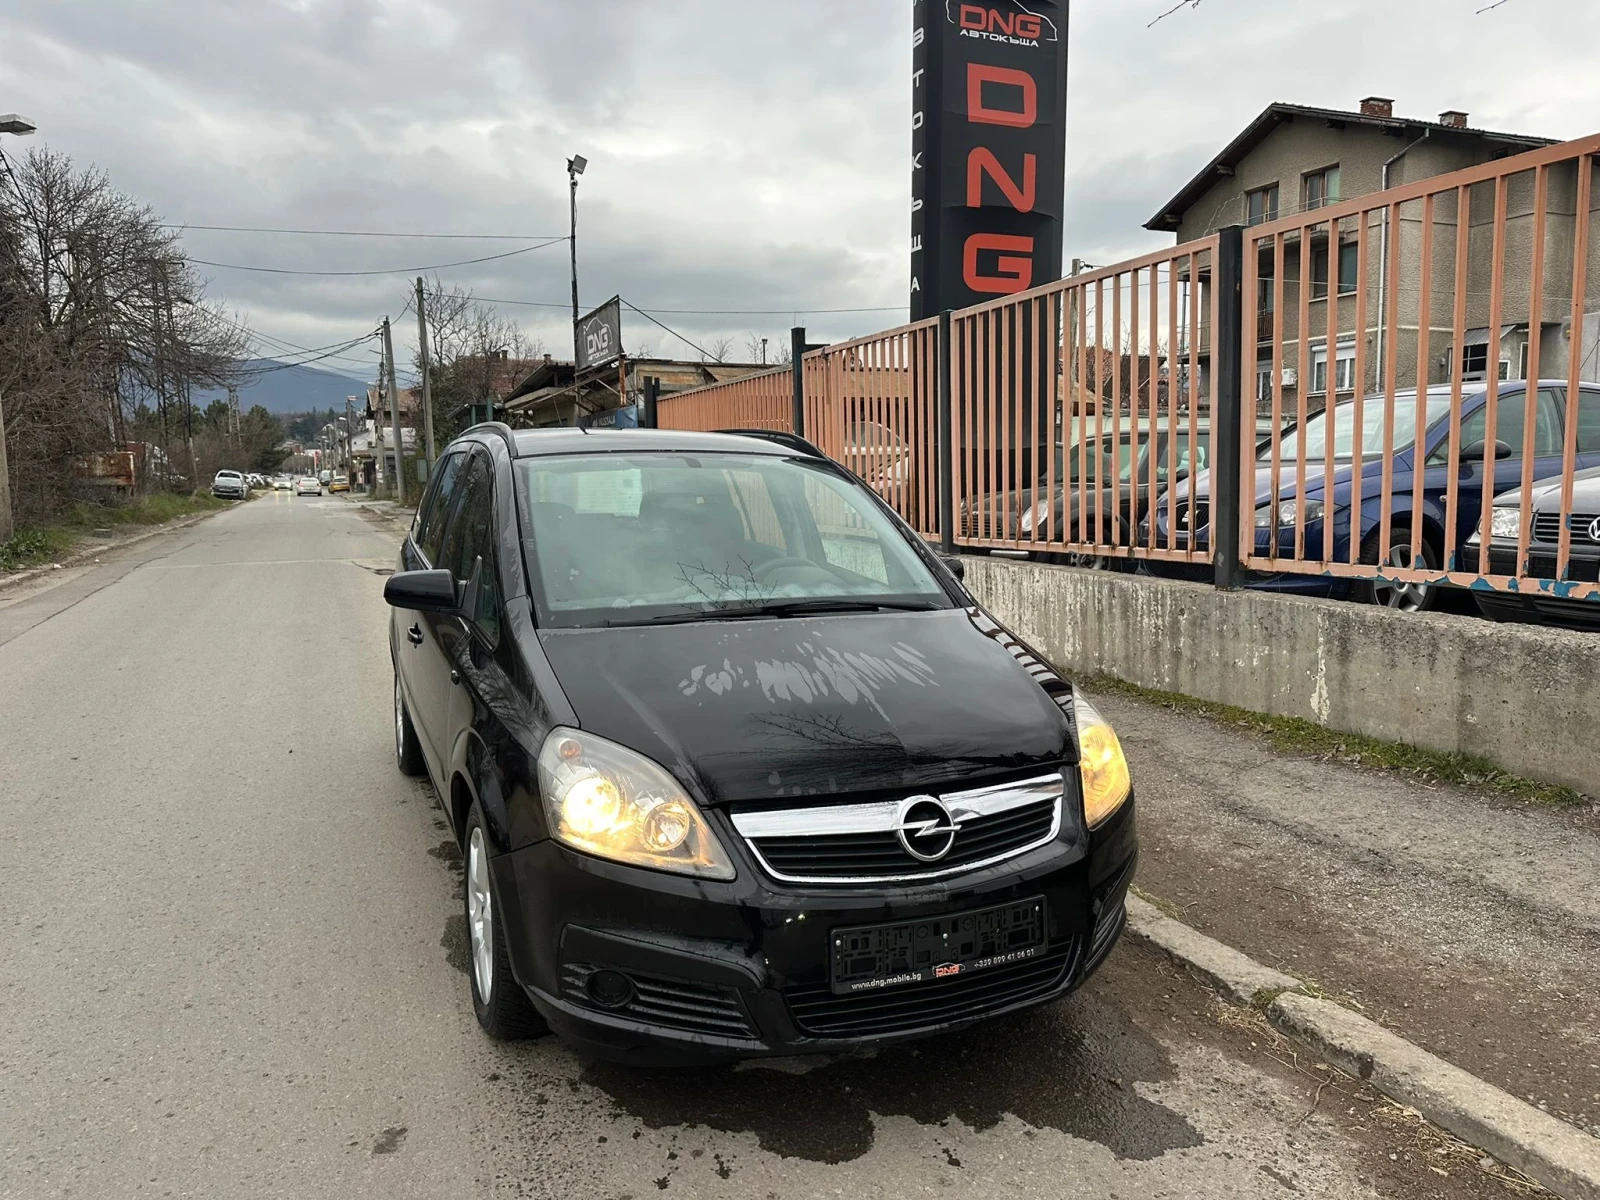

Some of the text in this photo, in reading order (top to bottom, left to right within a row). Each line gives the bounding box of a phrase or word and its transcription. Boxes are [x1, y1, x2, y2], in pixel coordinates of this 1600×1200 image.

[960, 4, 1041, 39] DNG
[963, 62, 1037, 294] DNG
[587, 326, 608, 355] DNG
[974, 948, 1034, 968] +359 899 41 06 01
[851, 973, 921, 990] www.dng.mobile.bg
